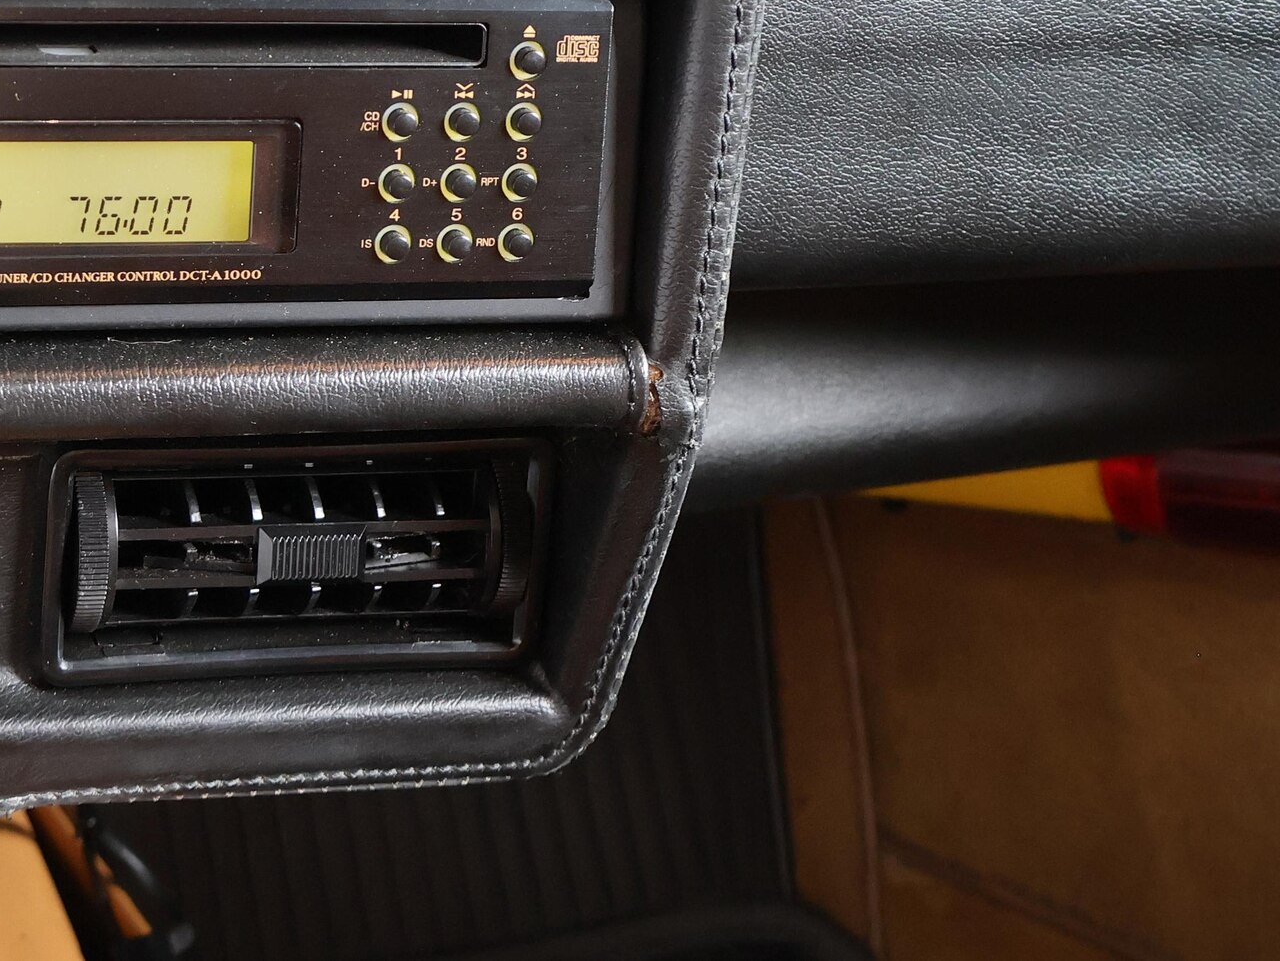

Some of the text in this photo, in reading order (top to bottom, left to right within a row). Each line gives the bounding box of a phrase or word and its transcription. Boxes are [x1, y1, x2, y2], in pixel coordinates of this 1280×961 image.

[364, 111, 380, 121] CD
[360, 122, 380, 132] /CH
[393, 148, 403, 161] 1
[454, 148, 466, 161] 2
[516, 147, 528, 160] 3
[480, 177, 499, 187] RPT
[389, 208, 401, 222] 4
[450, 208, 462, 221] 5
[511, 208, 523, 221] 6
[361, 239, 372, 249] IS
[419, 238, 434, 248] DS
[476, 237, 496, 247] RND
[54, 272, 115, 283] CHANGER
[117, 270, 177, 283] CONTROL
